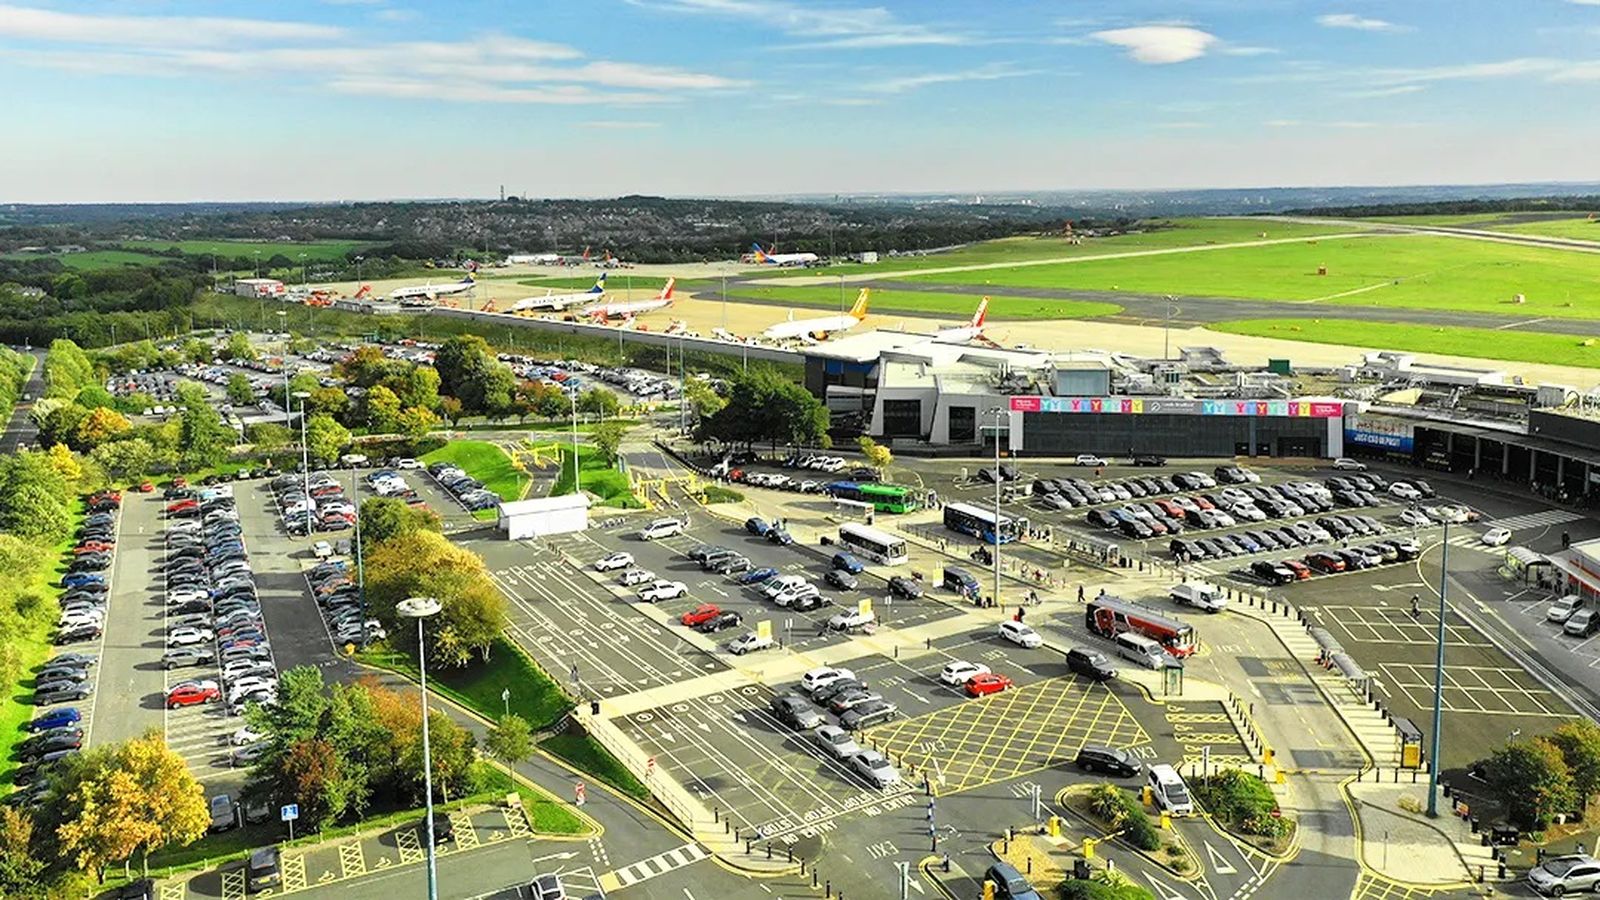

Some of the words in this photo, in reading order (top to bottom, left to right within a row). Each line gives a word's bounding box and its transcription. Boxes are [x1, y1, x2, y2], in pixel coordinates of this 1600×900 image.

[919, 739, 946, 754] EXIT
[844, 793, 873, 809] STOP
[862, 805, 882, 818] NO
[881, 794, 918, 811] ENTRY
[804, 806, 833, 822] STOP
[763, 819, 792, 835] STOP
[780, 833, 799, 846] NO
[800, 820, 838, 839] ENTRY
[865, 840, 900, 860] EXIT
